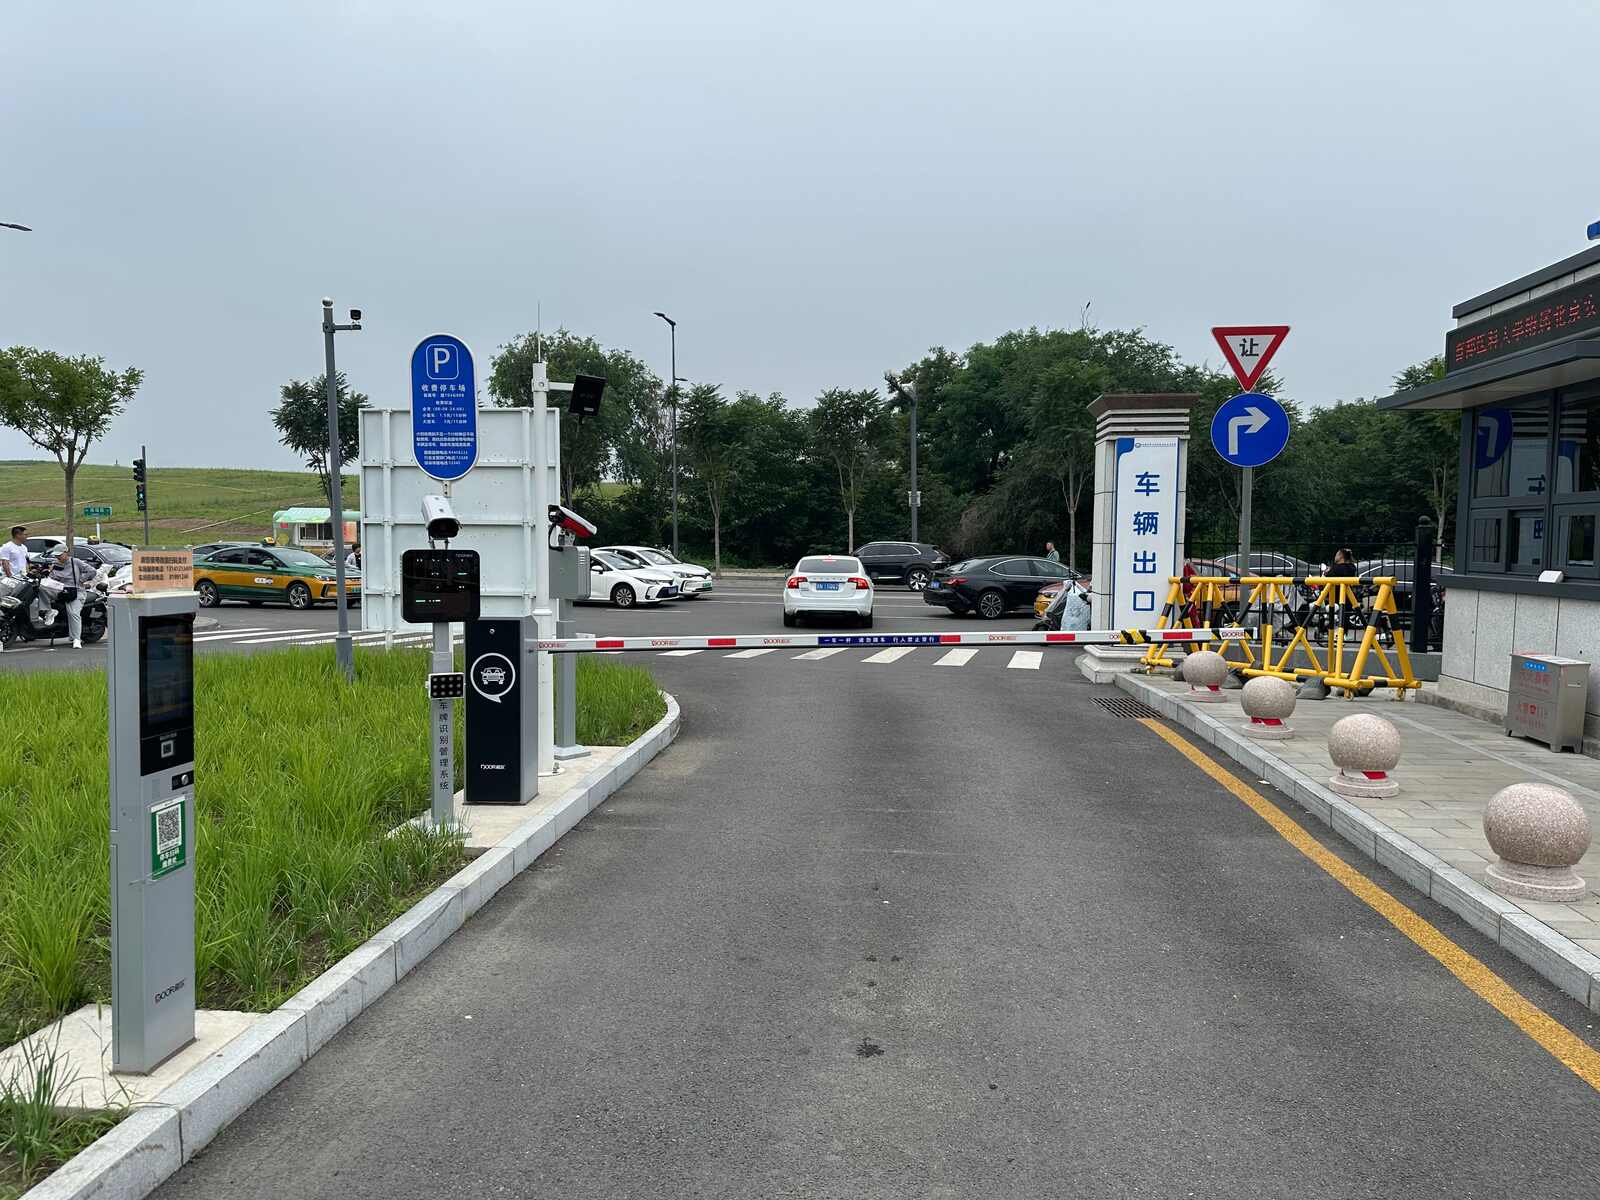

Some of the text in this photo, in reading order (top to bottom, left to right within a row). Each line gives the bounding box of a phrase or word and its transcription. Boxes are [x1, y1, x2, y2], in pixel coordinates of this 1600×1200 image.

[433, 346, 450, 374] P
[1239, 337, 1259, 357] 让
[421, 384, 466, 392] 收费停车场
[1132, 471, 1160, 612] 车辆出口
[439, 701, 449, 790] 车牌识别管理系统
